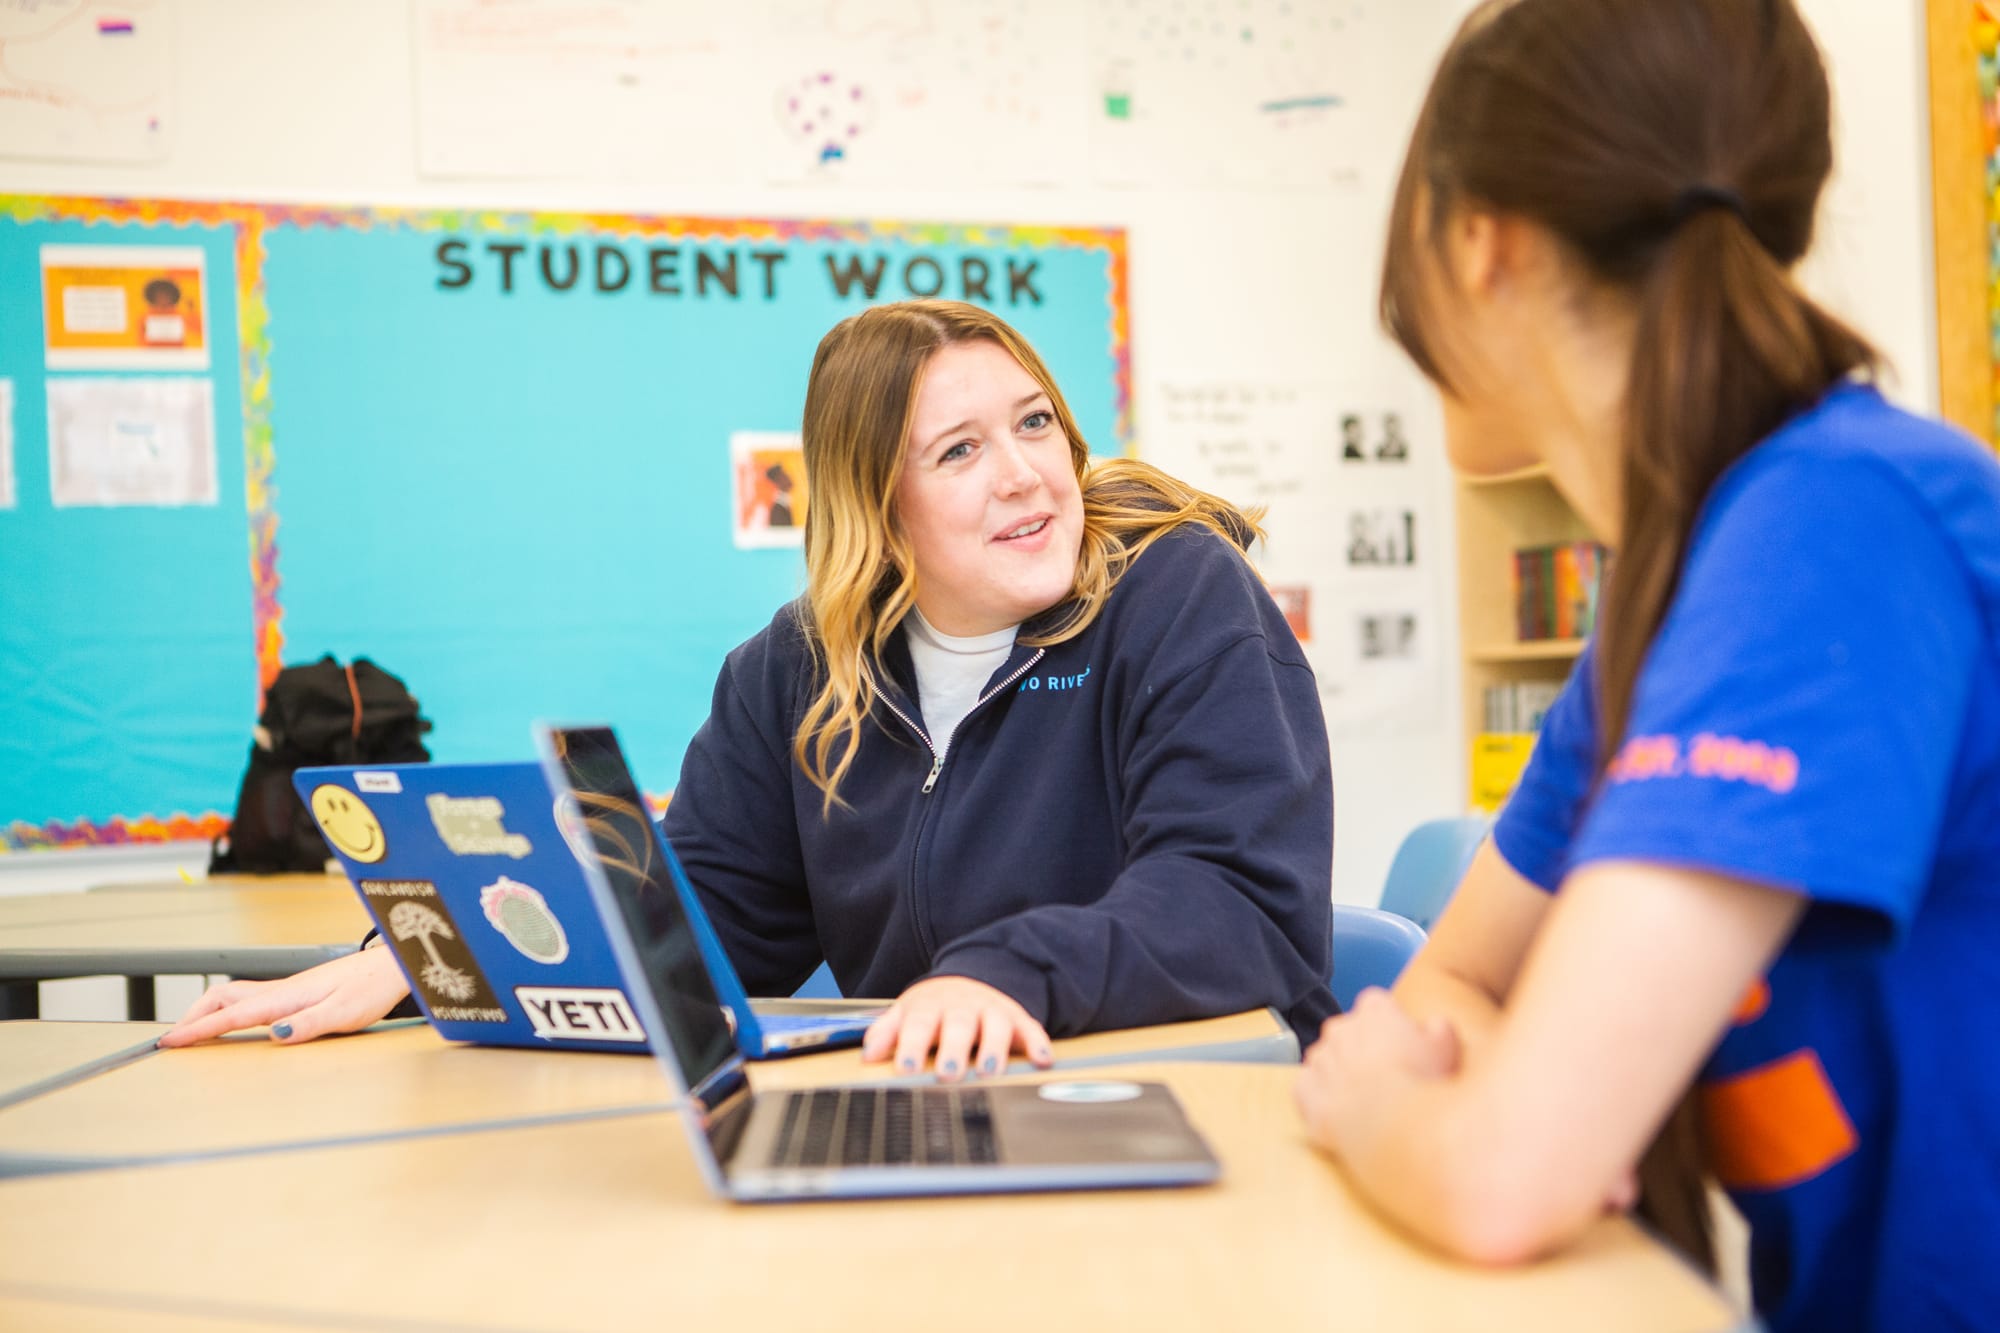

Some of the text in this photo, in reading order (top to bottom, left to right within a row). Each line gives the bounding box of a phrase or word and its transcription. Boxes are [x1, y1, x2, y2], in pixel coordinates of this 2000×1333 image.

[435, 240, 1046, 305] STUDENT WORK
[528, 998, 631, 1031] YETI
